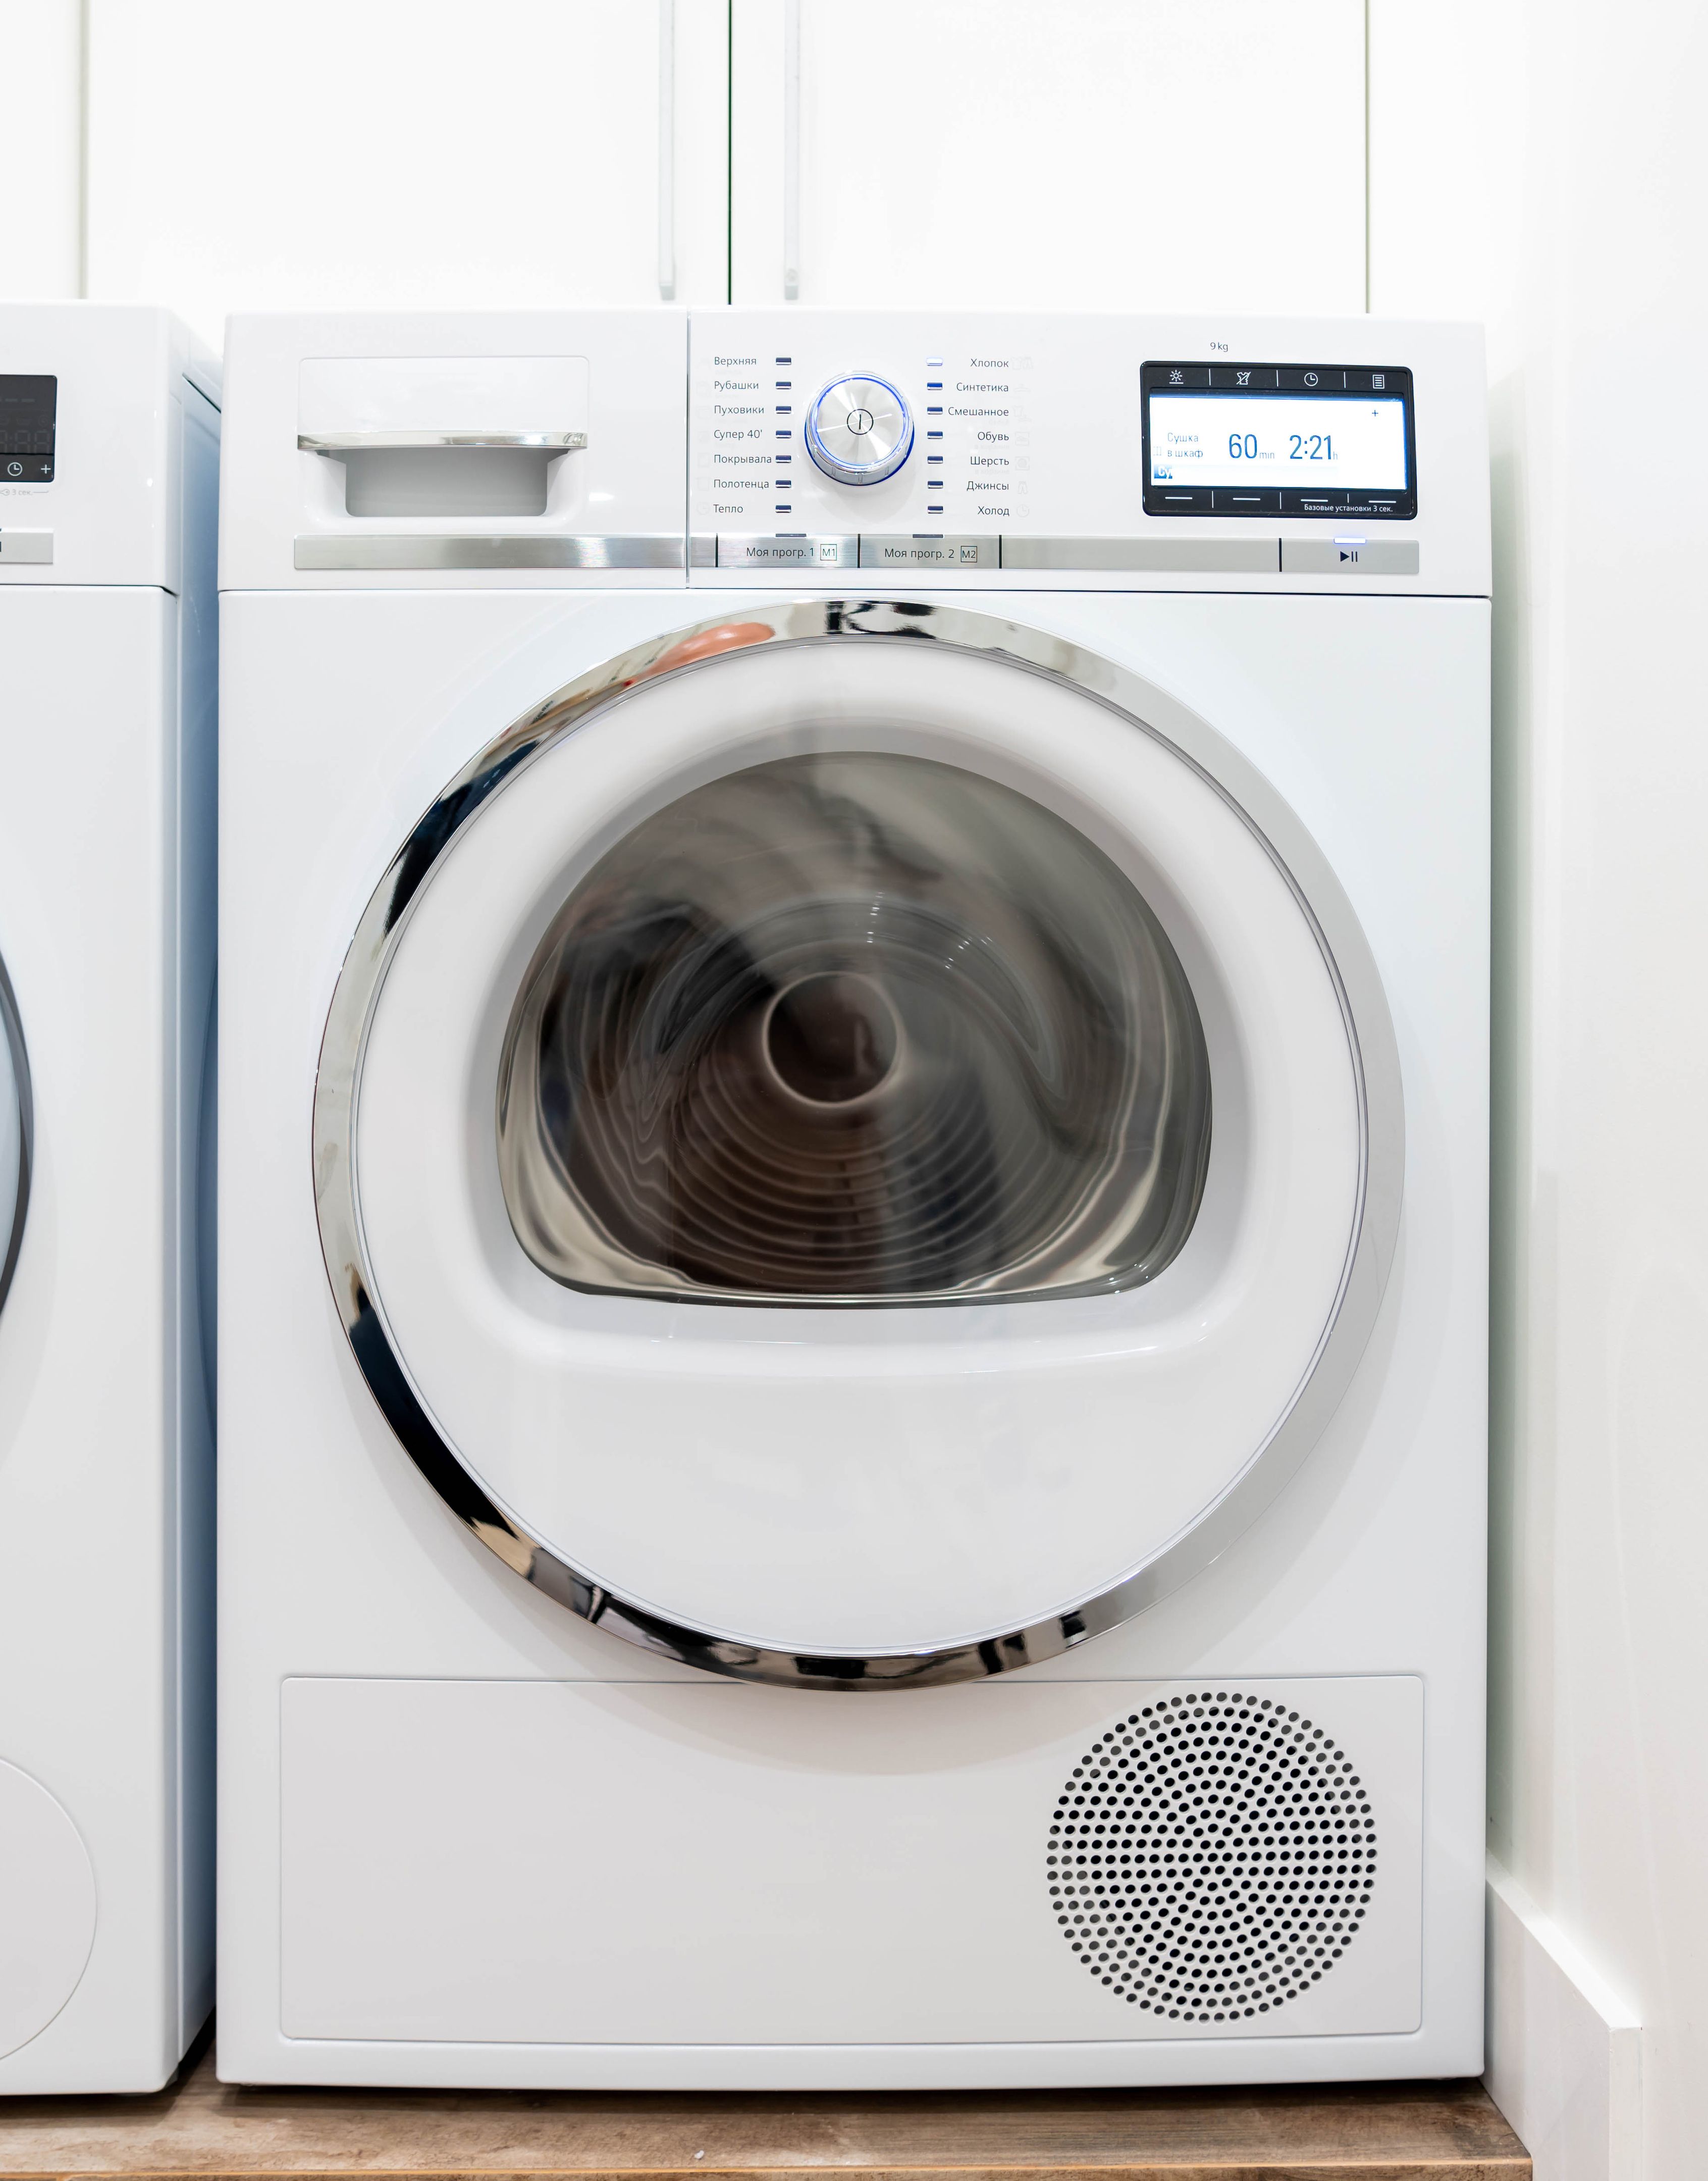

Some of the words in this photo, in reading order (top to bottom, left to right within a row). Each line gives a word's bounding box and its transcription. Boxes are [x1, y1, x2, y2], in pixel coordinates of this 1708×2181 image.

[714, 356, 757, 367] Верхняя
[970, 358, 1009, 368] Хлопок
[714, 380, 759, 392] Рубашки
[956, 382, 1008, 392] Синтетика
[714, 405, 764, 417] Пуховики
[948, 406, 1009, 417] Смешанное
[714, 430, 744, 441] Супер
[977, 431, 1009, 443] Обувь
[1167, 432, 1198, 444] Сушка
[1229, 434, 1257, 459] 60
[1290, 435, 1331, 460] 2:21
[714, 454, 772, 465] Покрывала
[1175, 449, 1203, 459] шкаф
[970, 456, 1009, 468] Шерсть
[714, 479, 769, 490] Полотенца
[967, 481, 1009, 492] Джинсы
[713, 504, 743, 513] Тепло
[978, 506, 1009, 516] Холод
[746, 547, 769, 557] Моя
[772, 549, 806, 559] прогр.
[810, 547, 814, 556] 1
[822, 548, 835, 556] M1
[885, 548, 907, 558] Моя
[911, 550, 944, 561] прогр.
[948, 549, 954, 558] 2
[962, 550, 976, 558] M2
